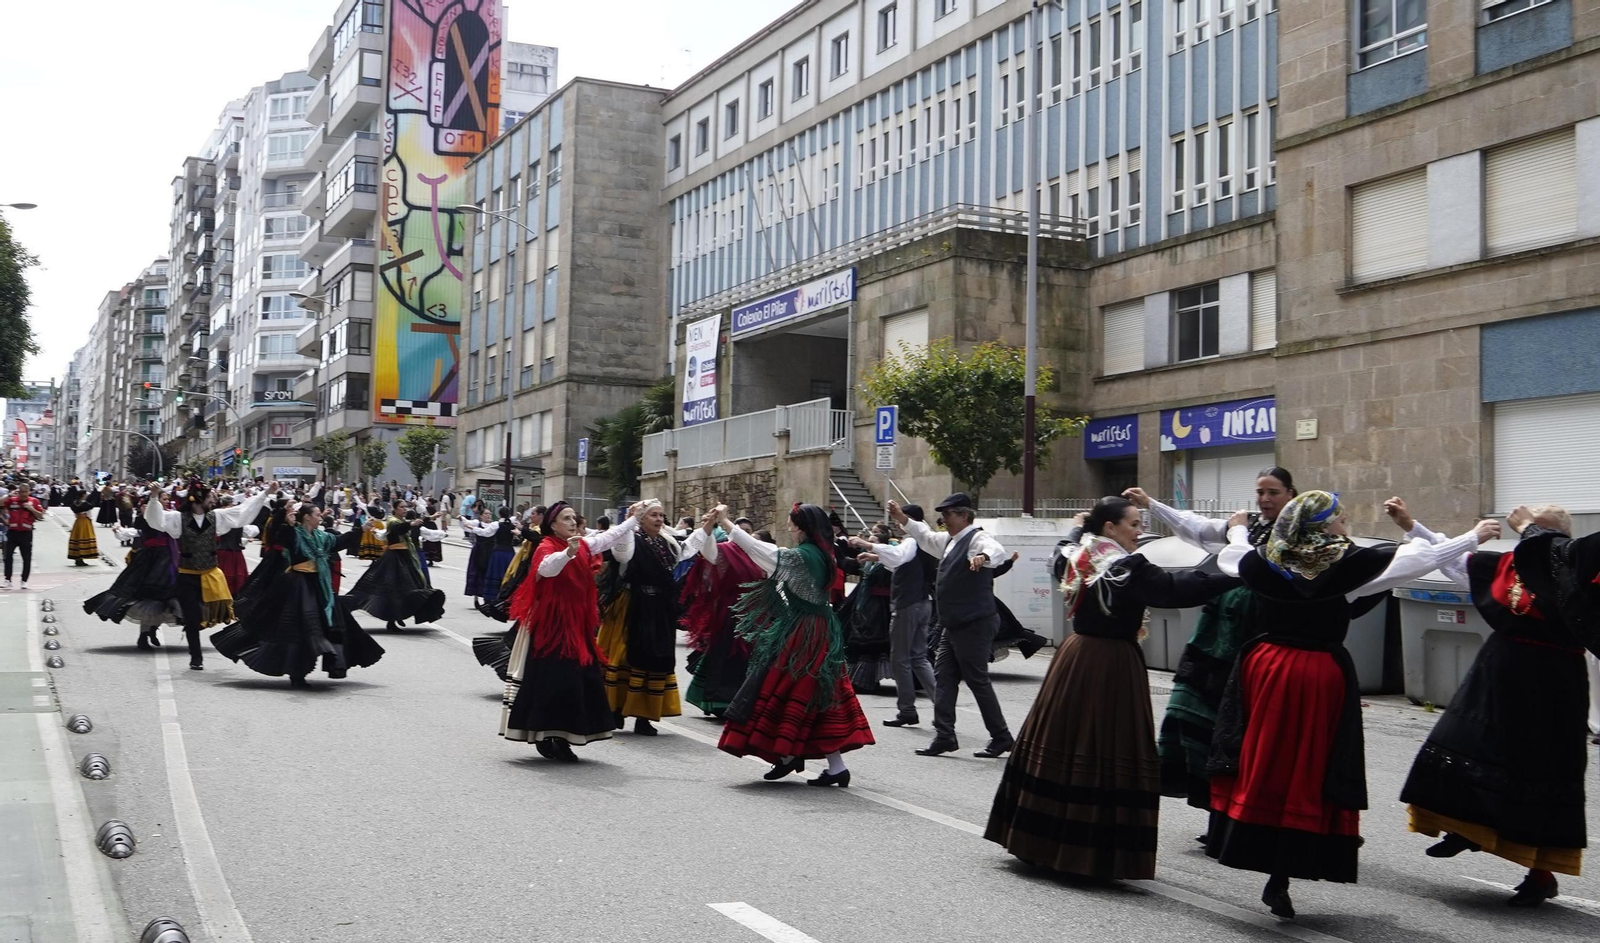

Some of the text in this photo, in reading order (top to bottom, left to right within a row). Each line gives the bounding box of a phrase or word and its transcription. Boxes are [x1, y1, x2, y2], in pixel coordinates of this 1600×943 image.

[807, 274, 851, 309] maristas
[737, 301, 788, 327] Colexio El Pilar
[683, 399, 717, 422] maristas
[879, 410, 891, 439] P
[1091, 423, 1132, 443] maristas
